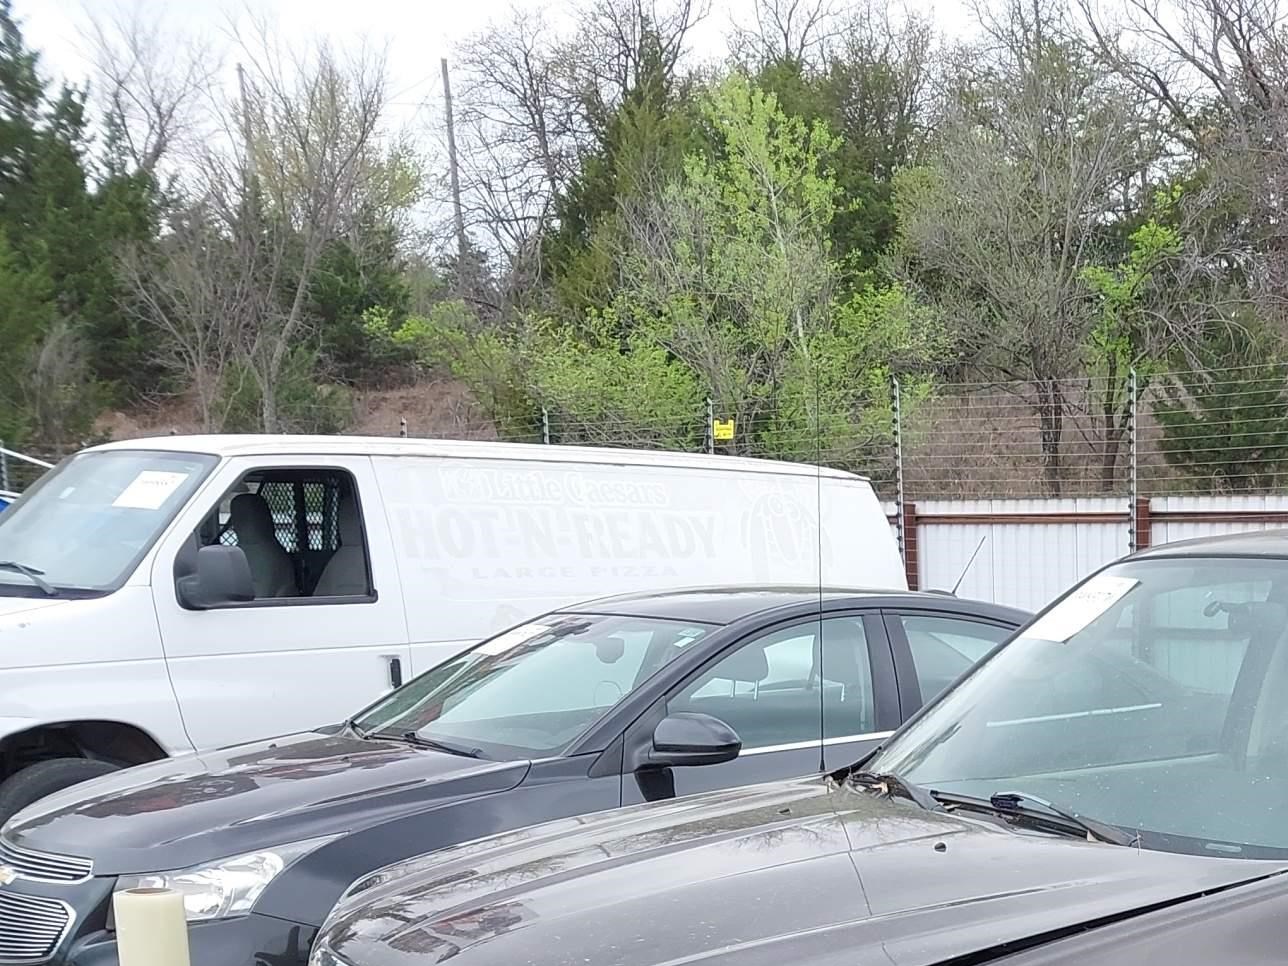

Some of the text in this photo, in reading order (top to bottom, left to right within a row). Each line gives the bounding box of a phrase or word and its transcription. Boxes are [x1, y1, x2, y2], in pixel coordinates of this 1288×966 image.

[491, 469, 667, 505] Little Caesars
[471, 566, 680, 580] LARGE PIZZA
